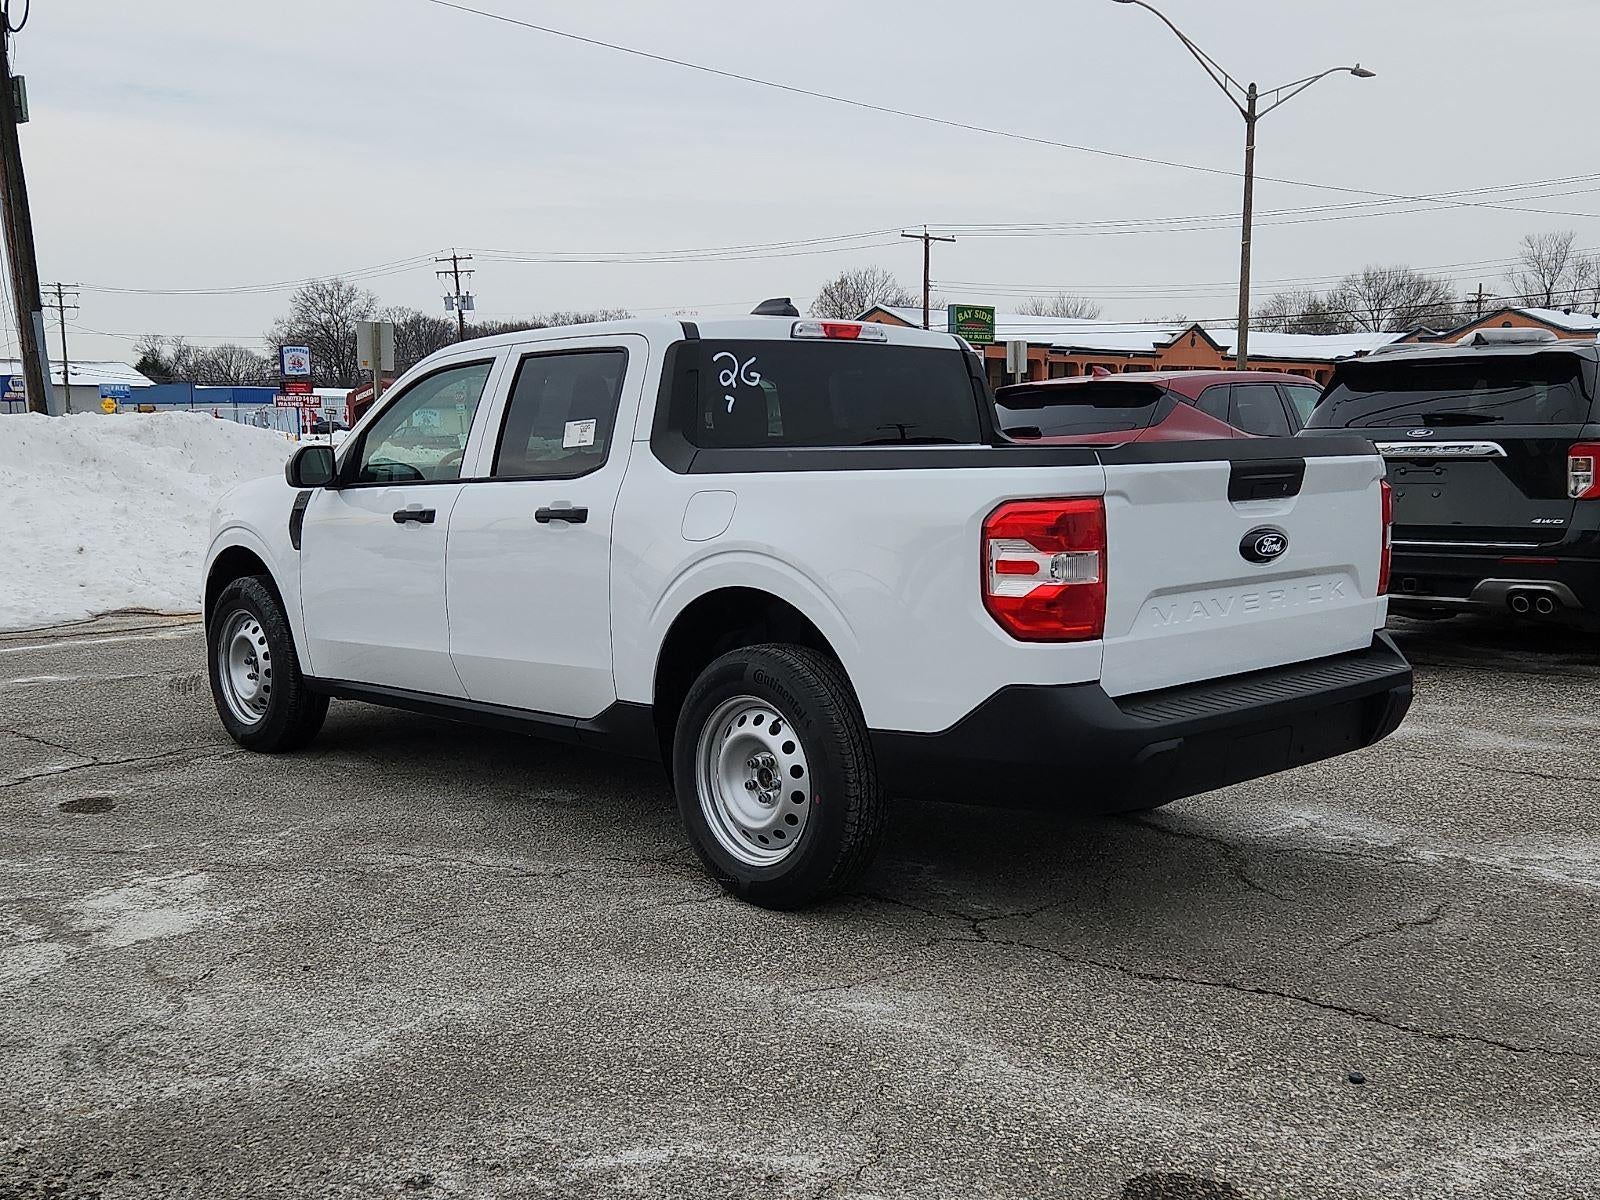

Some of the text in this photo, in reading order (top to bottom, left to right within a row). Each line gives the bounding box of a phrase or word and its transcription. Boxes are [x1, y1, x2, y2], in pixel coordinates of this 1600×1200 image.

[957, 309, 993, 324] BAY SIDE
[1260, 537, 1283, 554] Ford
[1151, 579, 1346, 628] MAVERICK
